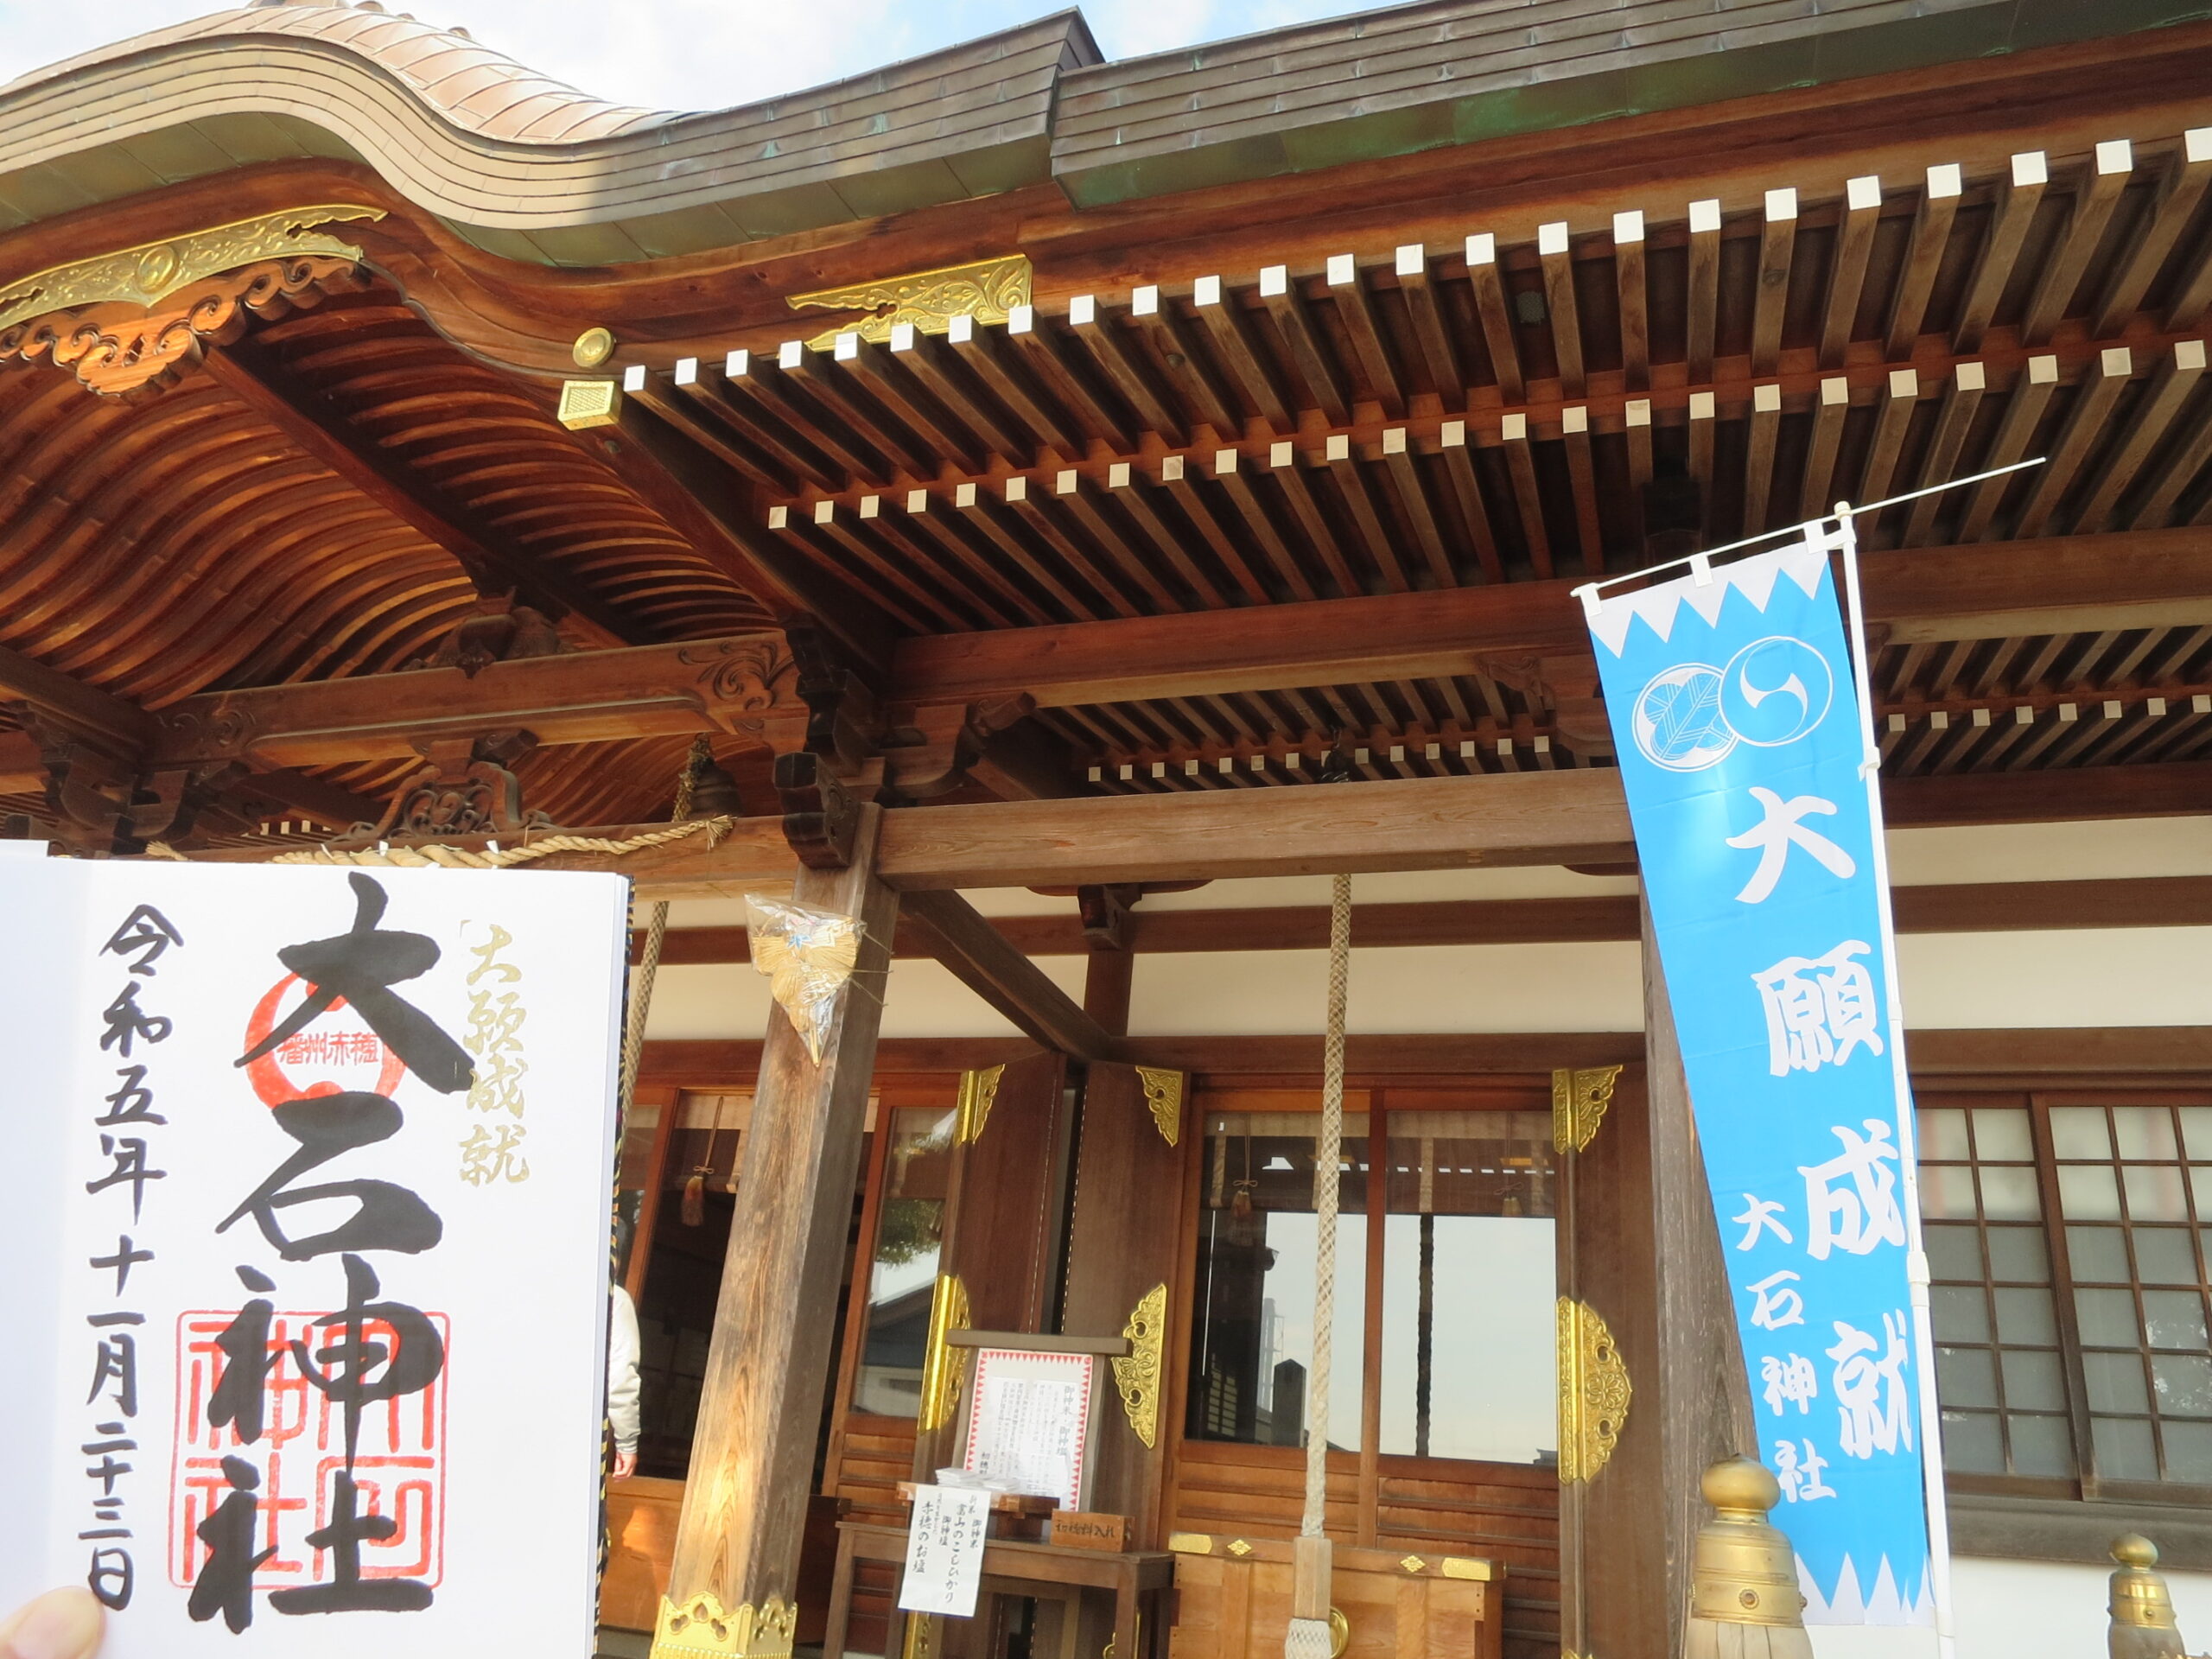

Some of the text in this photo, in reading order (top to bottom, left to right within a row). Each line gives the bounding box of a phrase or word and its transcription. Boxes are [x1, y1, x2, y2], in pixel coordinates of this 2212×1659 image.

[78, 904, 184, 1611] 令和五年十一月二十三日
[188, 872, 475, 1635] 大石神社
[1726, 786, 1912, 1459] 大願成就
[1732, 1193, 1837, 1503] 大石神社
